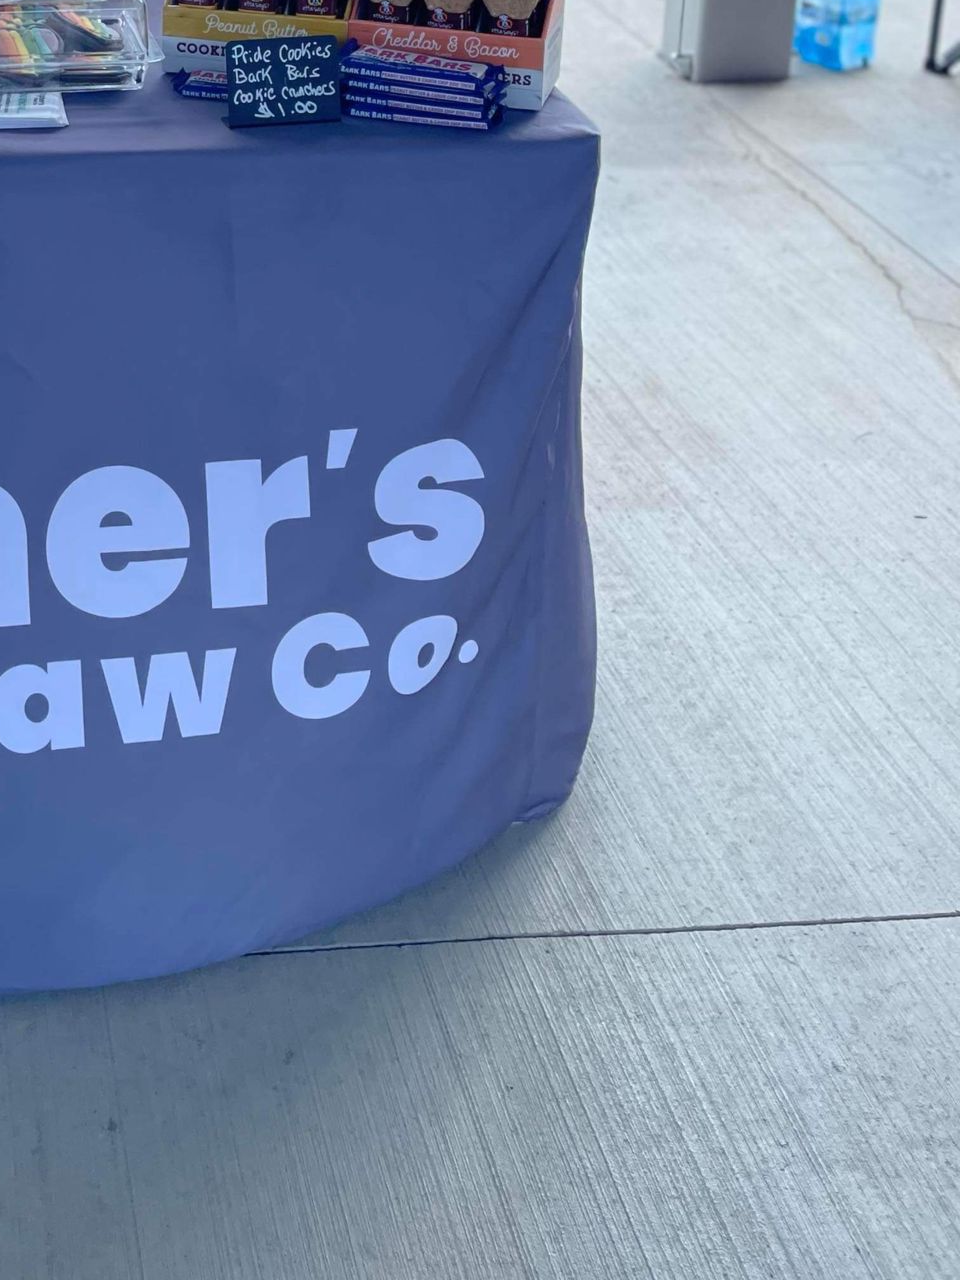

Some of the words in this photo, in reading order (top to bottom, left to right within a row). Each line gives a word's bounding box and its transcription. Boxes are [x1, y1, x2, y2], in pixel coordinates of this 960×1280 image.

[203, 14, 258, 36] Peanut
[231, 44, 271, 65] Pride
[279, 41, 332, 63] Cookies
[372, 27, 441, 50] Cheddar
[447, 36, 458, 52] &
[464, 36, 519, 60] Bacon
[415, 54, 473, 71] BARS
[233, 65, 273, 85] Bark
[285, 64, 320, 81] Bars
[272, 612, 479, 720] Co.
